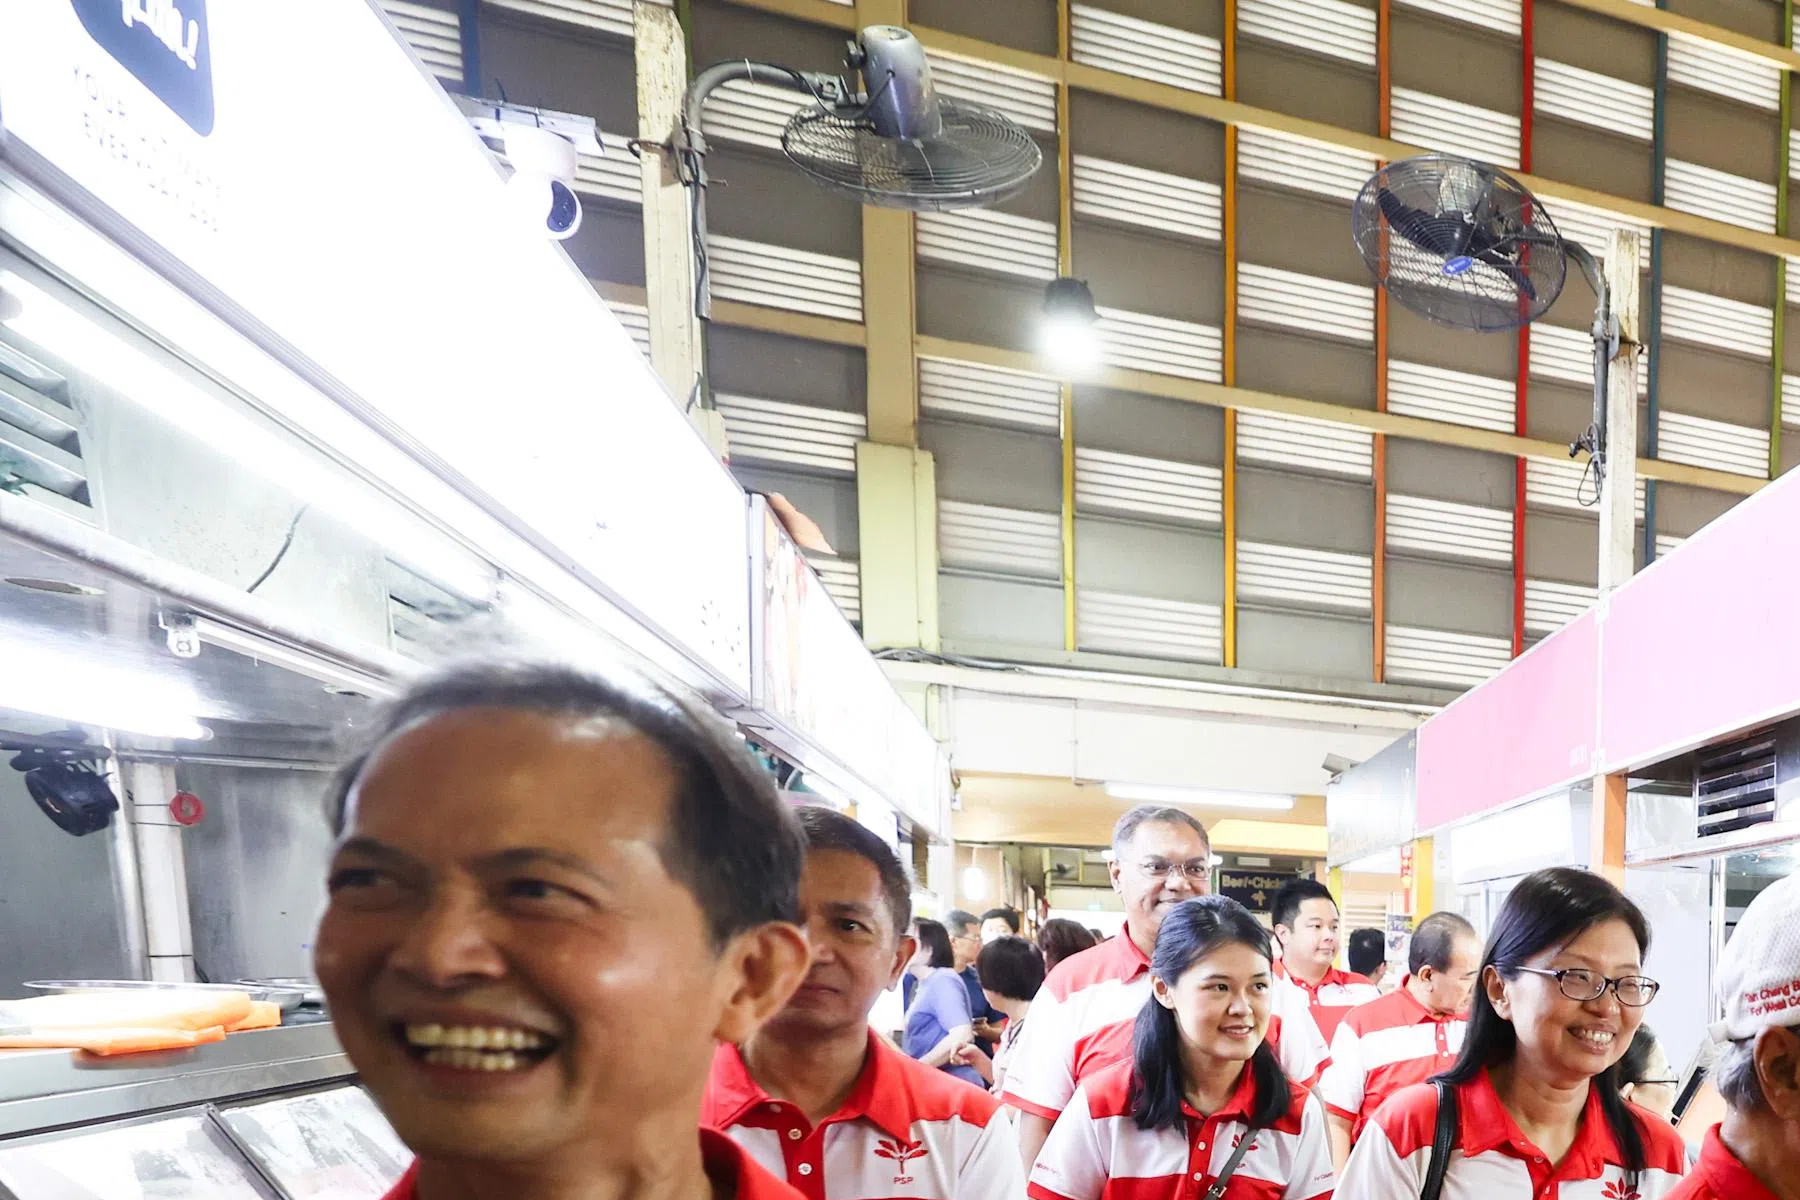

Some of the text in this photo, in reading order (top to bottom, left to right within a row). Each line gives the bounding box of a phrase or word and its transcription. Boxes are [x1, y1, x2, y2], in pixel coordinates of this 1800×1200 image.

[1760, 985, 1790, 999] Cheng
[1751, 1007, 1762, 1015] For
[893, 1176, 914, 1185] PSP
